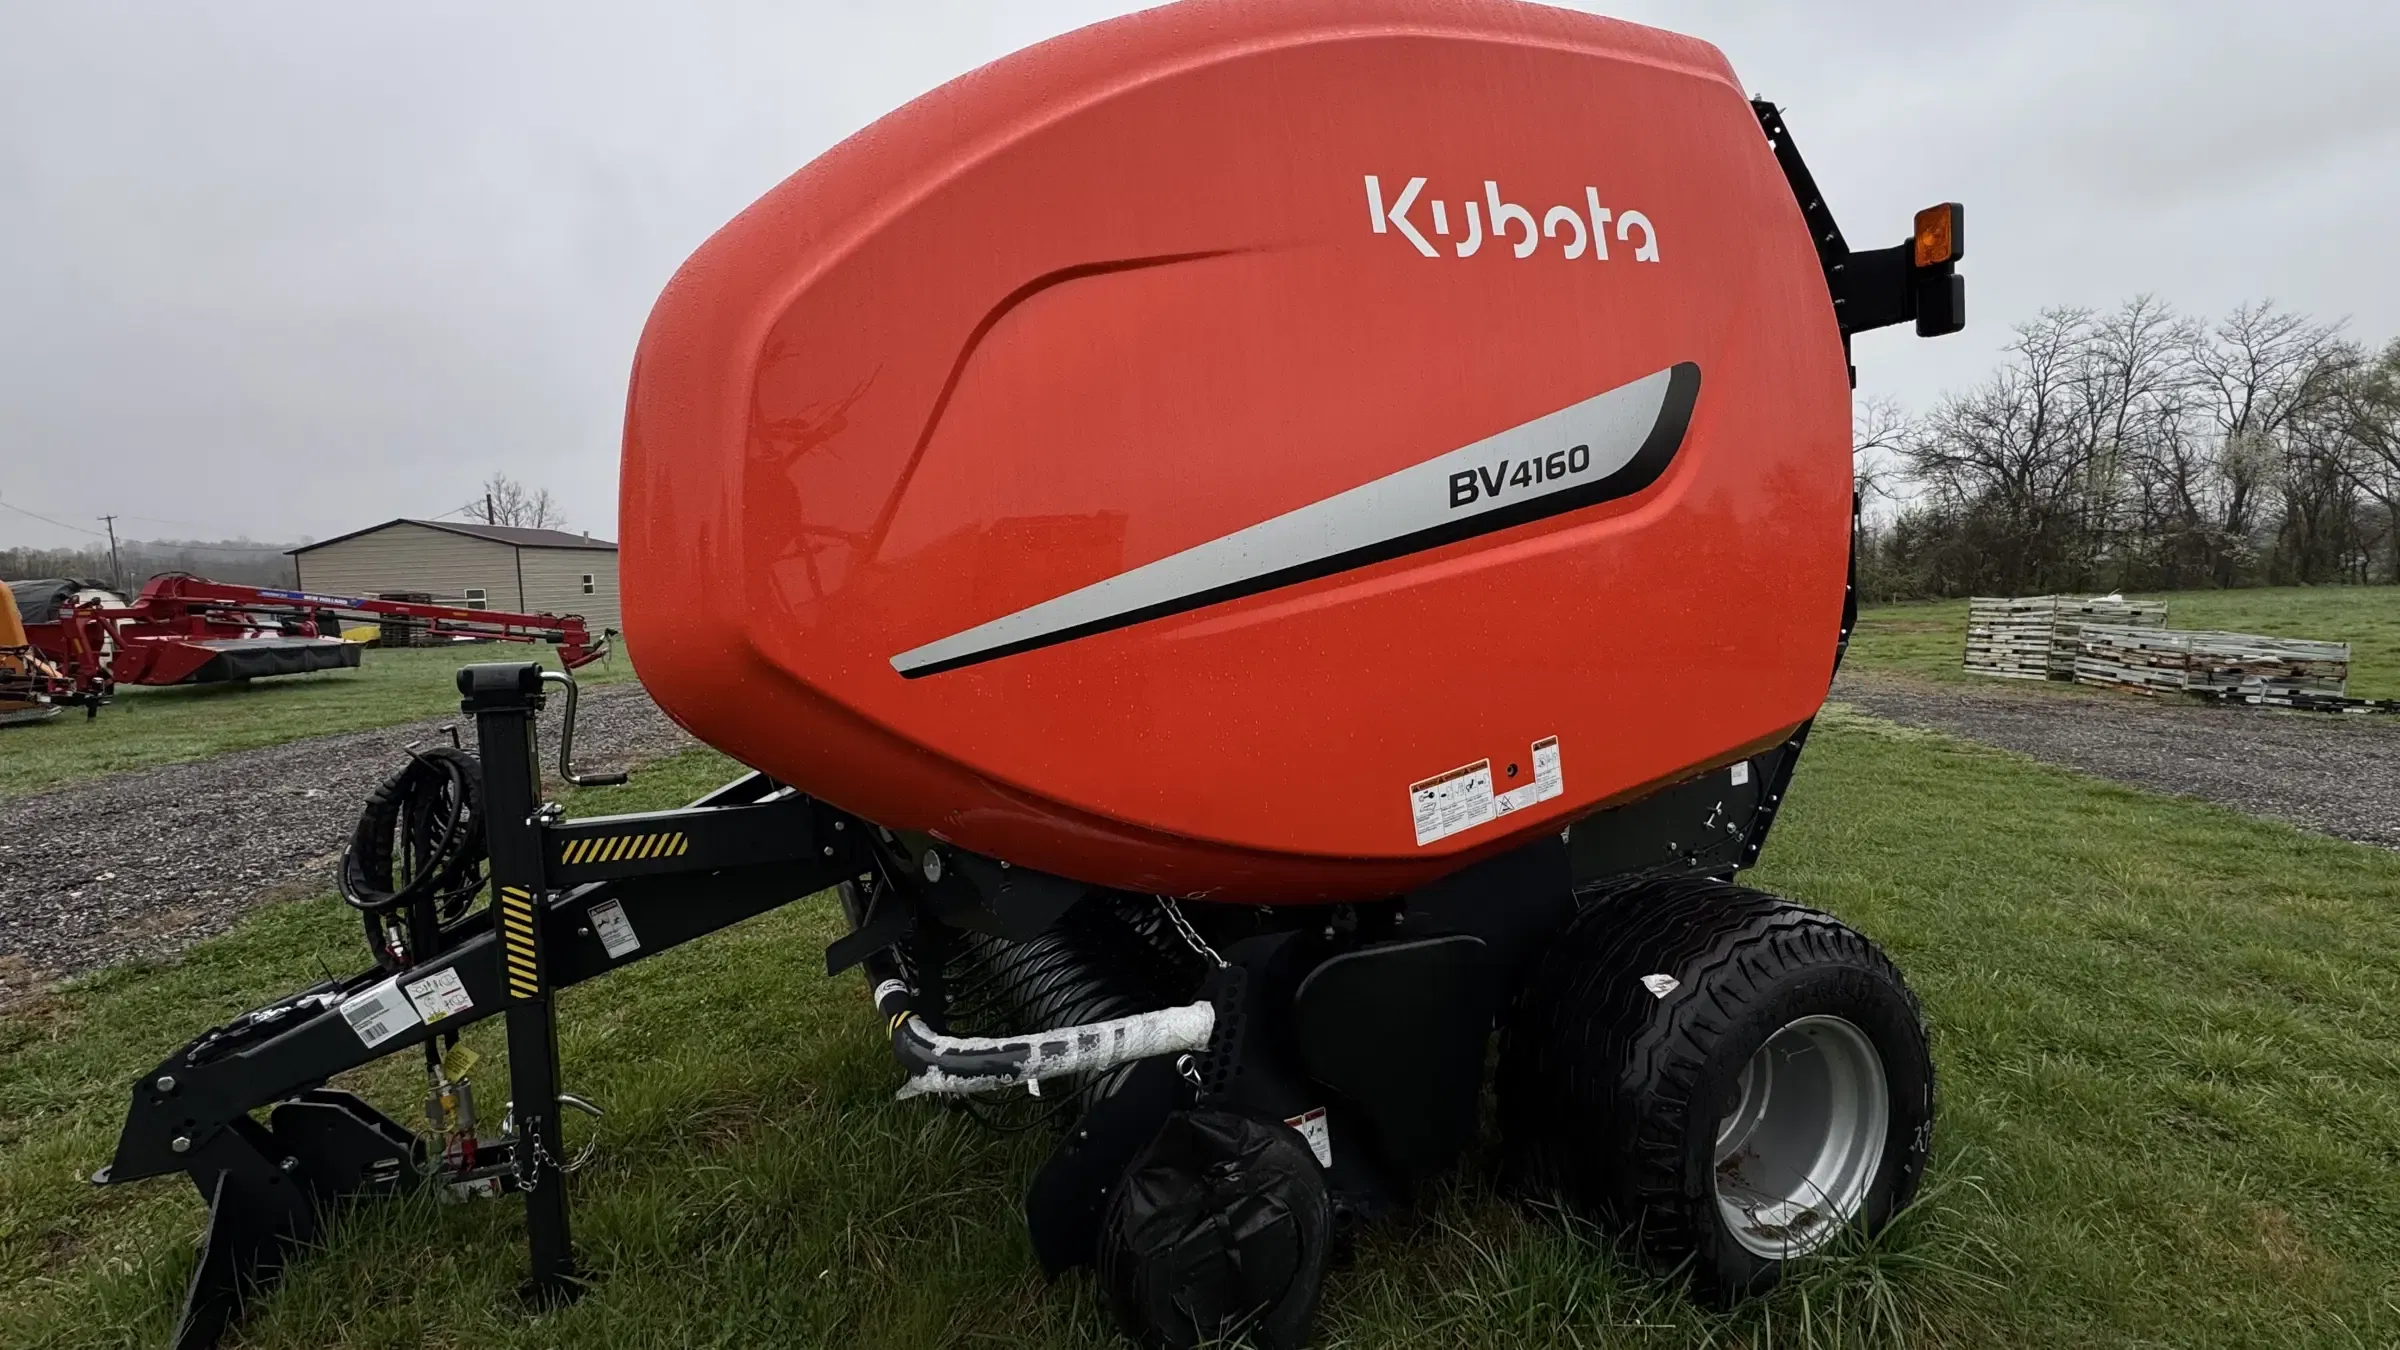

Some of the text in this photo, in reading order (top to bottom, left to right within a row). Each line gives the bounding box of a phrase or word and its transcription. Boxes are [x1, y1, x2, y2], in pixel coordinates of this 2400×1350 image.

[1364, 175, 1660, 262] Kubota
[1449, 444, 1590, 509] BV4160
[319, 595, 348, 605] HOLLAND
